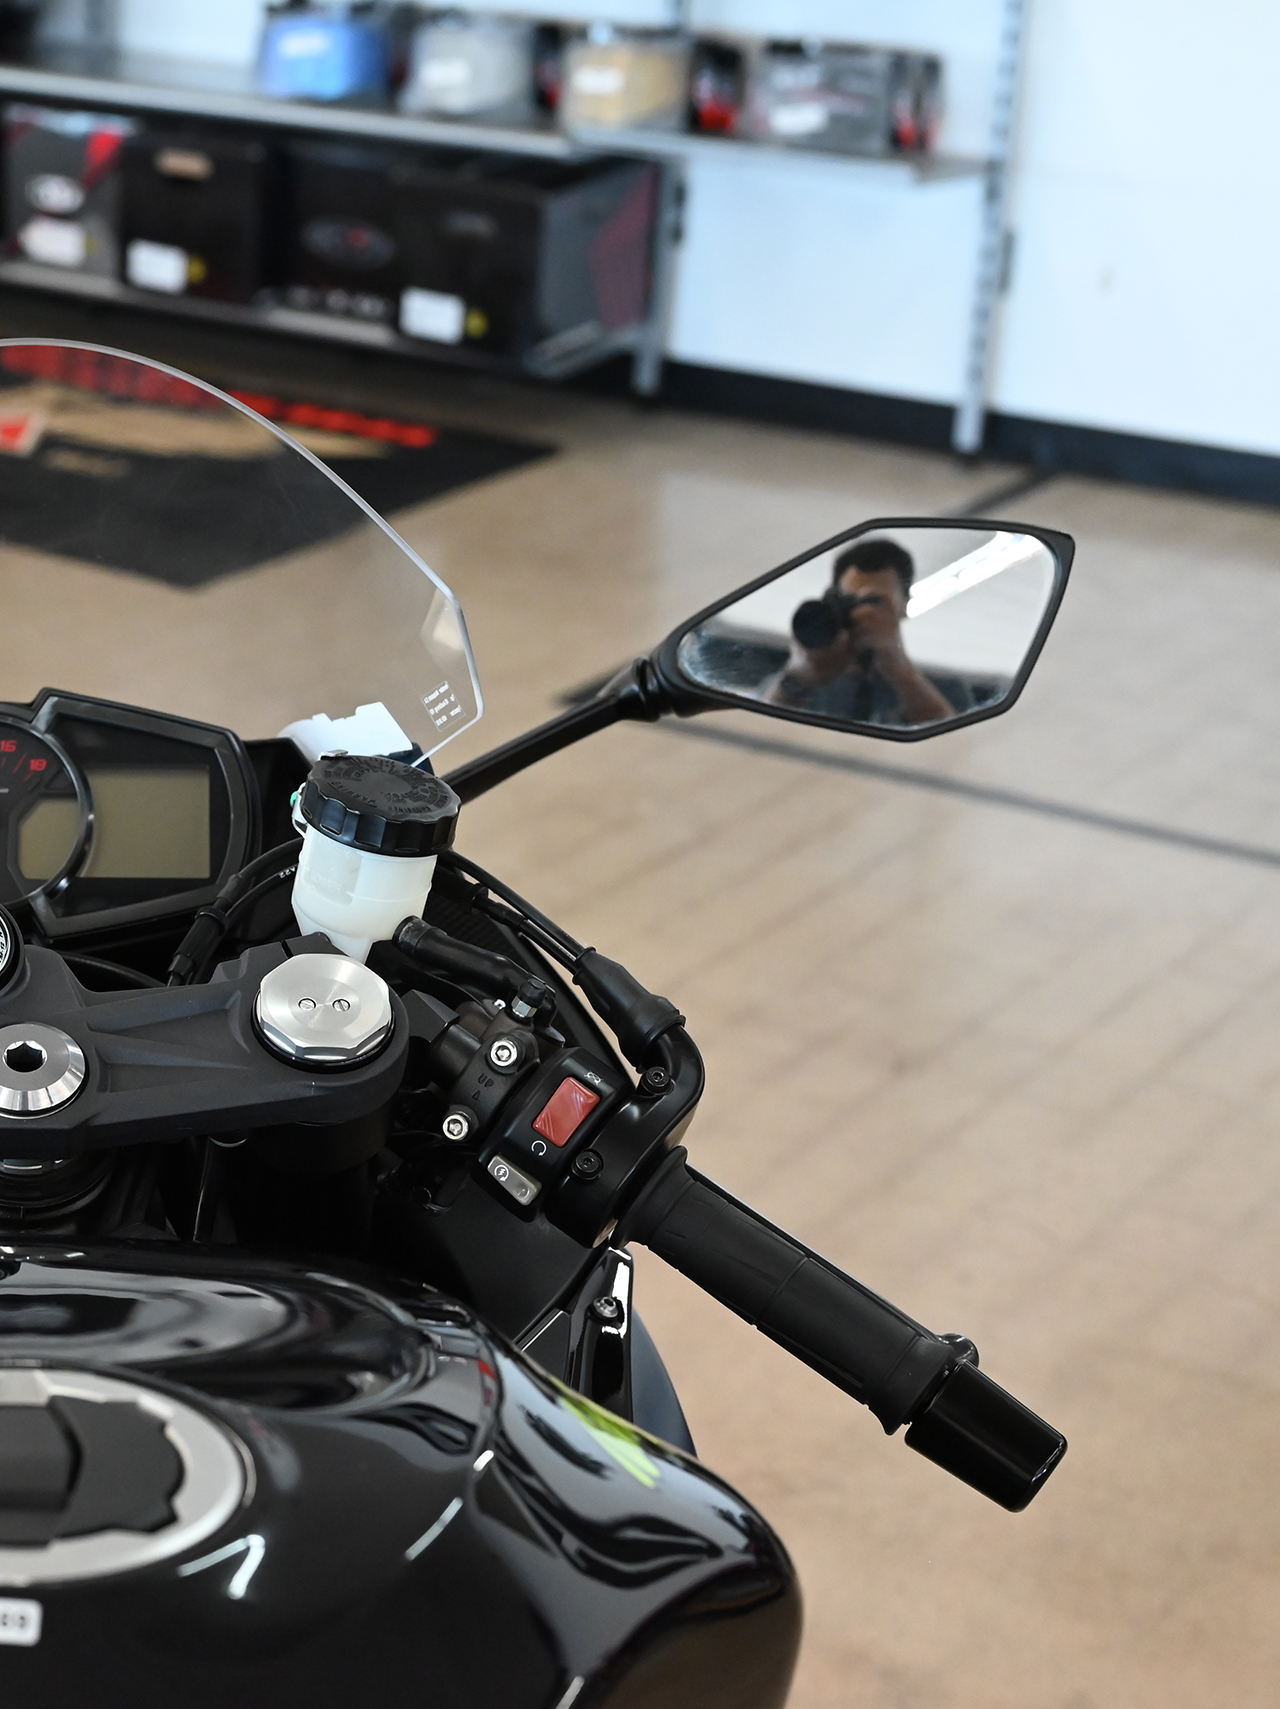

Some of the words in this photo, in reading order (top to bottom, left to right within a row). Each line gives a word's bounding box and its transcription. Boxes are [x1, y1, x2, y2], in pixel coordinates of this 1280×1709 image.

[0, 740, 17, 752] 16
[29, 759, 47, 771] 18
[477, 1073, 494, 1088] UP
